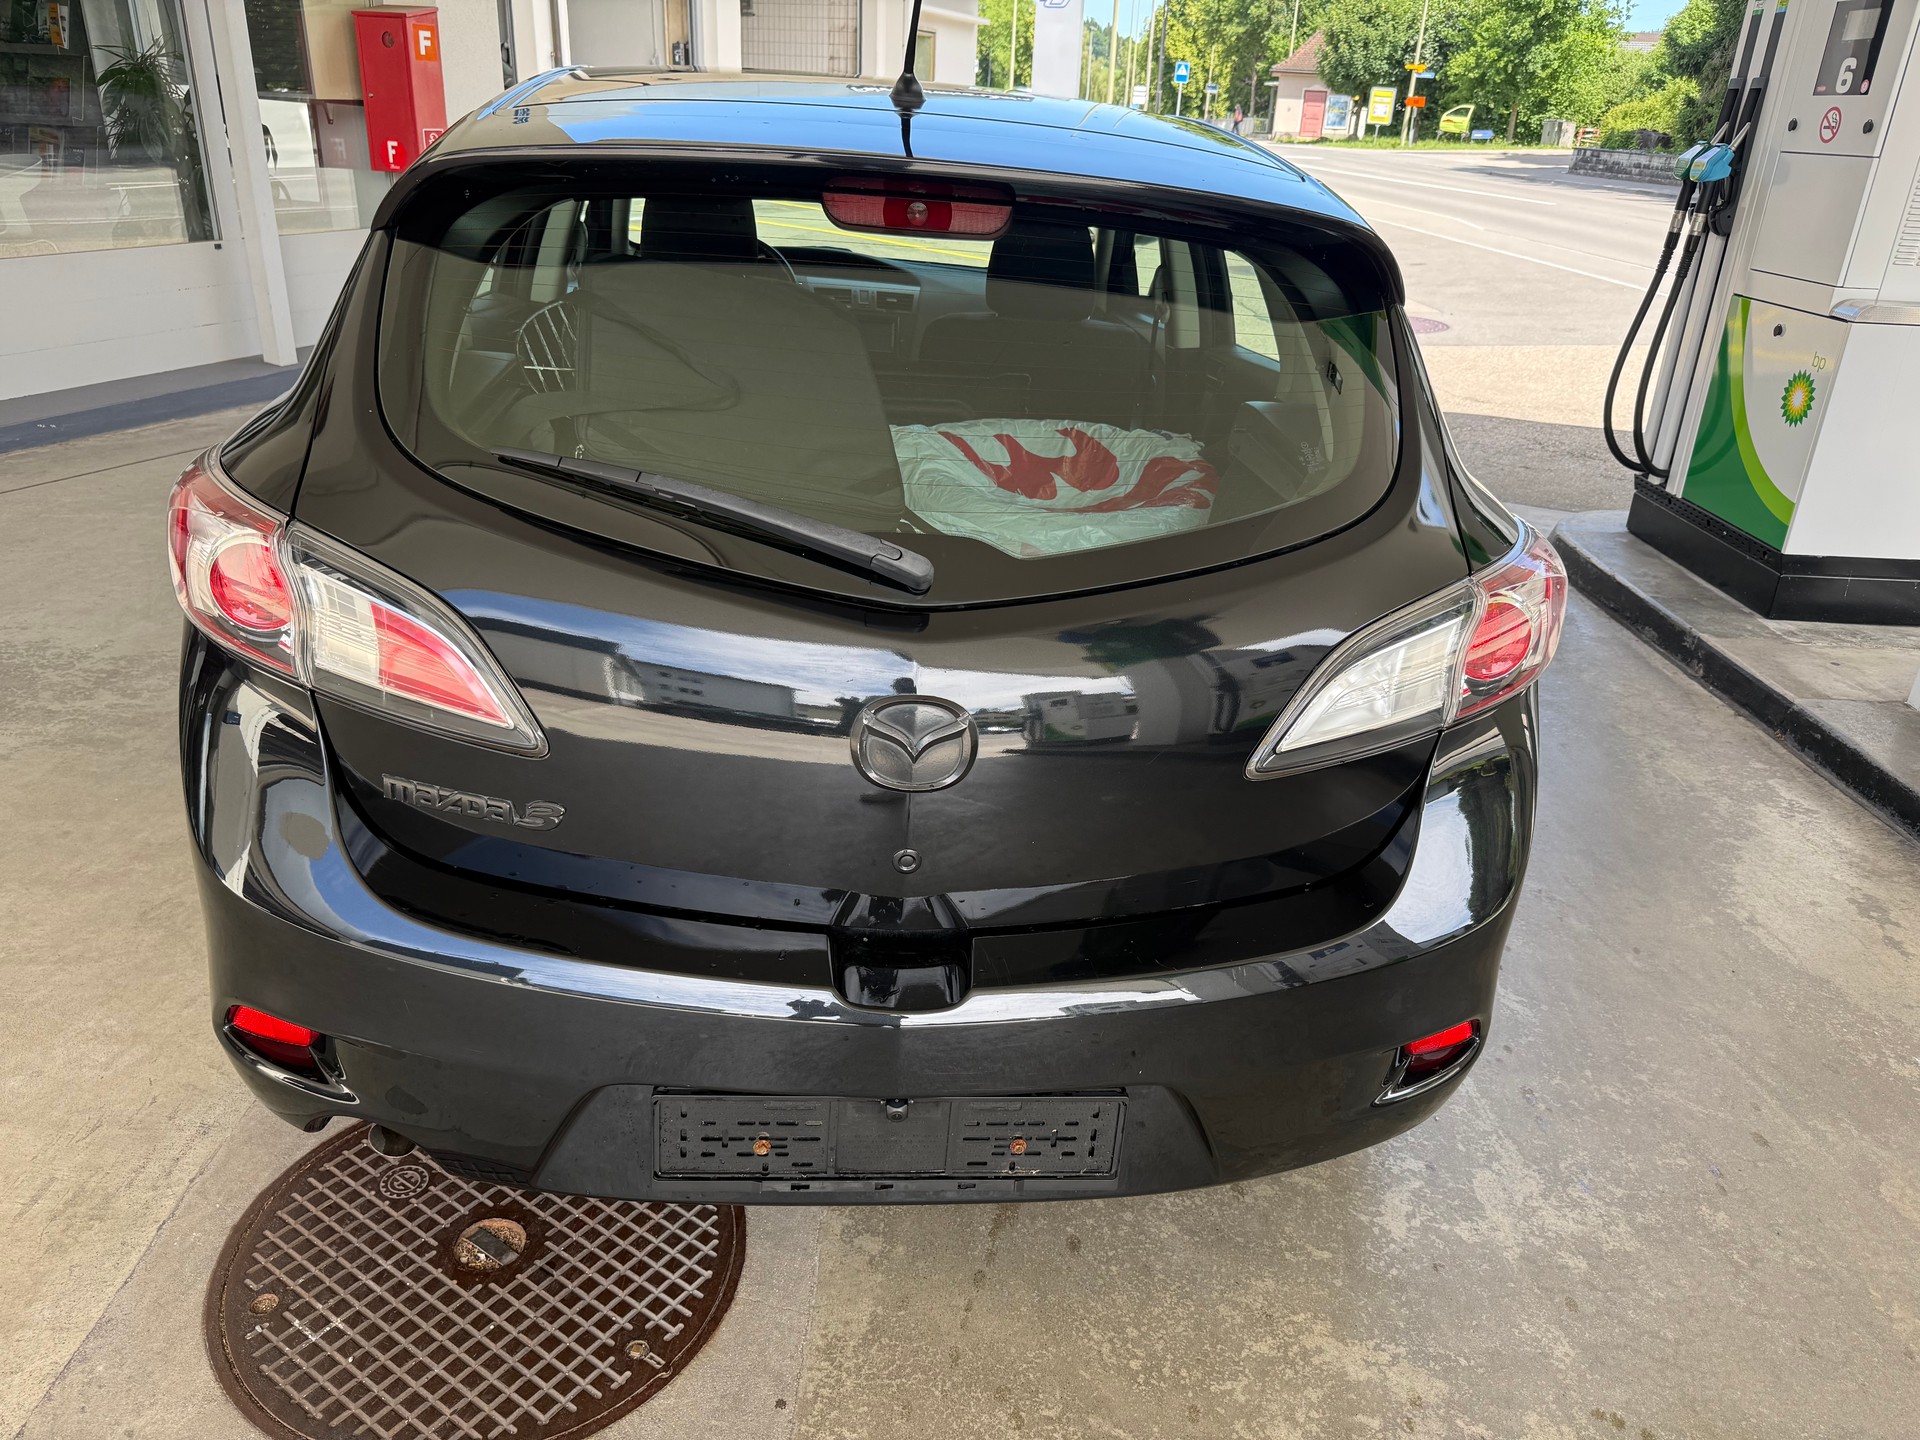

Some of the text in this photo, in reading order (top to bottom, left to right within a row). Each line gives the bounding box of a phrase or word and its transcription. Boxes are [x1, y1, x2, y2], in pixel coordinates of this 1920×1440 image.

[418, 29, 432, 56] F
[1835, 57, 1858, 94] 6
[386, 140, 398, 164] F
[1811, 351, 1827, 373] bp
